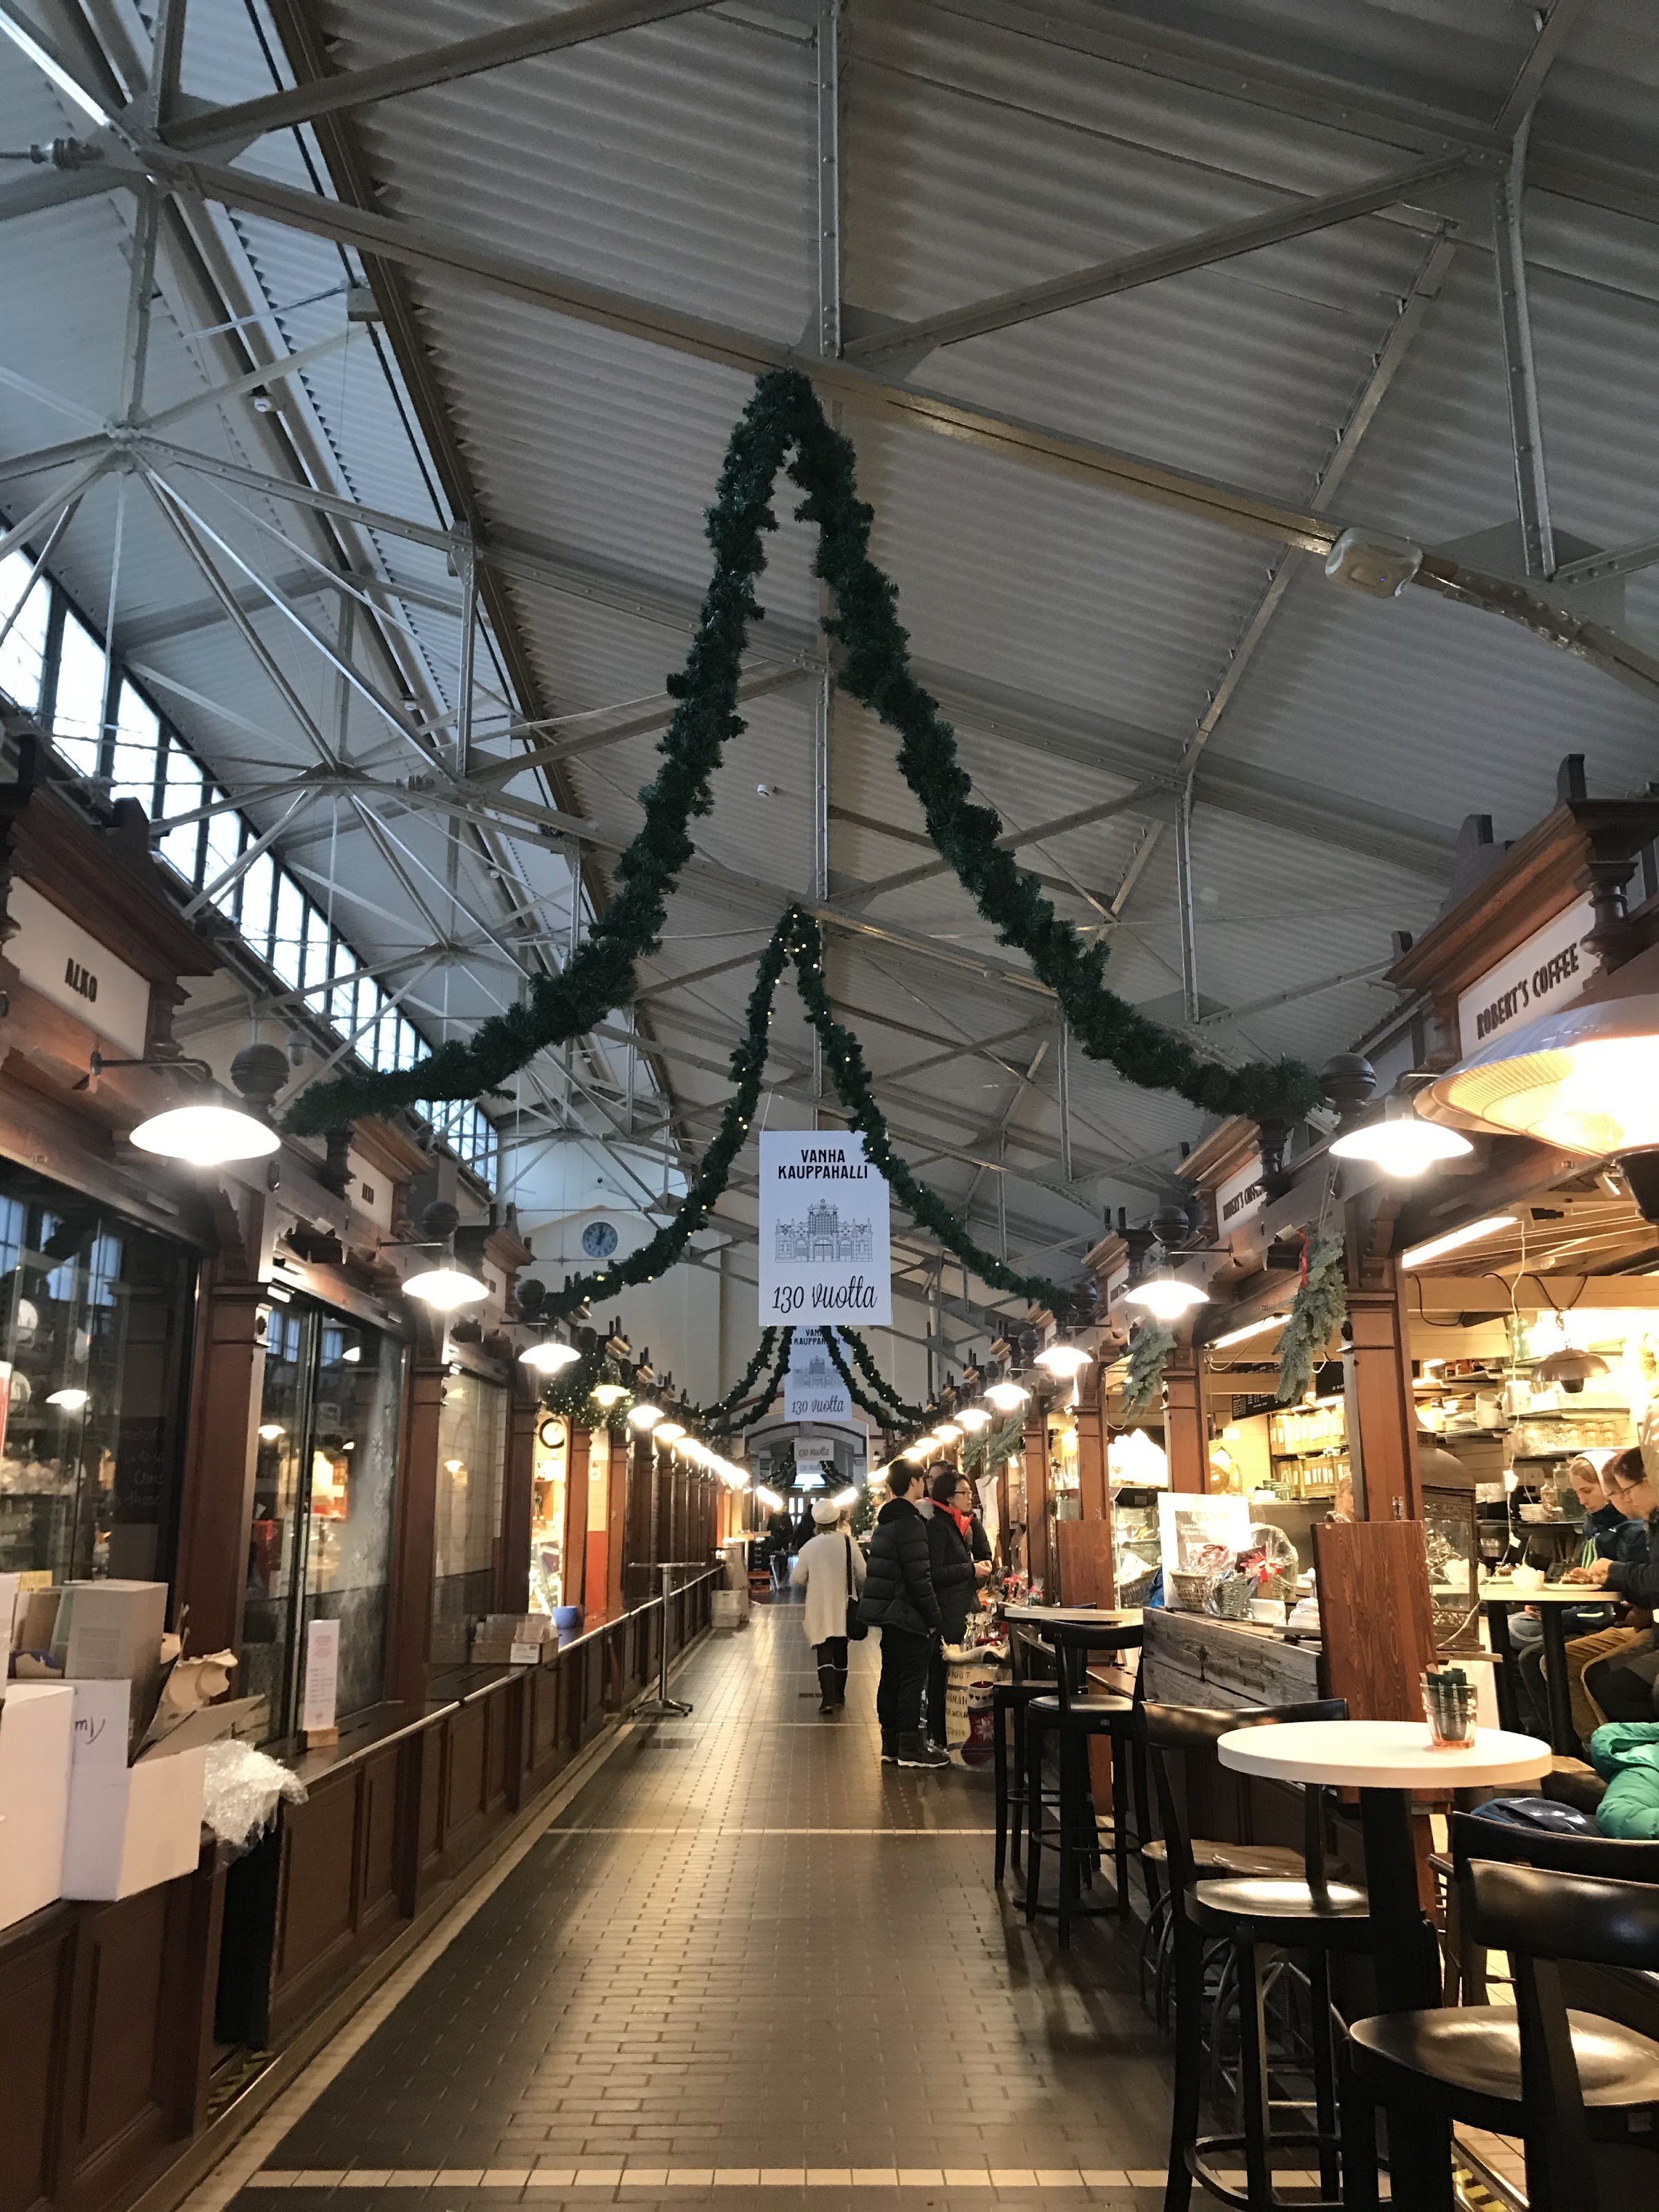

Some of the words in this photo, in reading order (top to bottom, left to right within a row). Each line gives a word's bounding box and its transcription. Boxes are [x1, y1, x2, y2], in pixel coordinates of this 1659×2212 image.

[65, 957, 97, 1003] ALKO
[1477, 978, 1529, 1040] ROBERT'S
[1532, 943, 1580, 997] COFFEE
[800, 1149, 845, 1163] VANHA
[778, 1165, 868, 1179] KAUPPAHALLI
[772, 1286, 805, 1314] 130
[812, 1275, 878, 1309] vuotta
[791, 1400, 808, 1416] 130
[812, 1395, 845, 1413] vuotta
